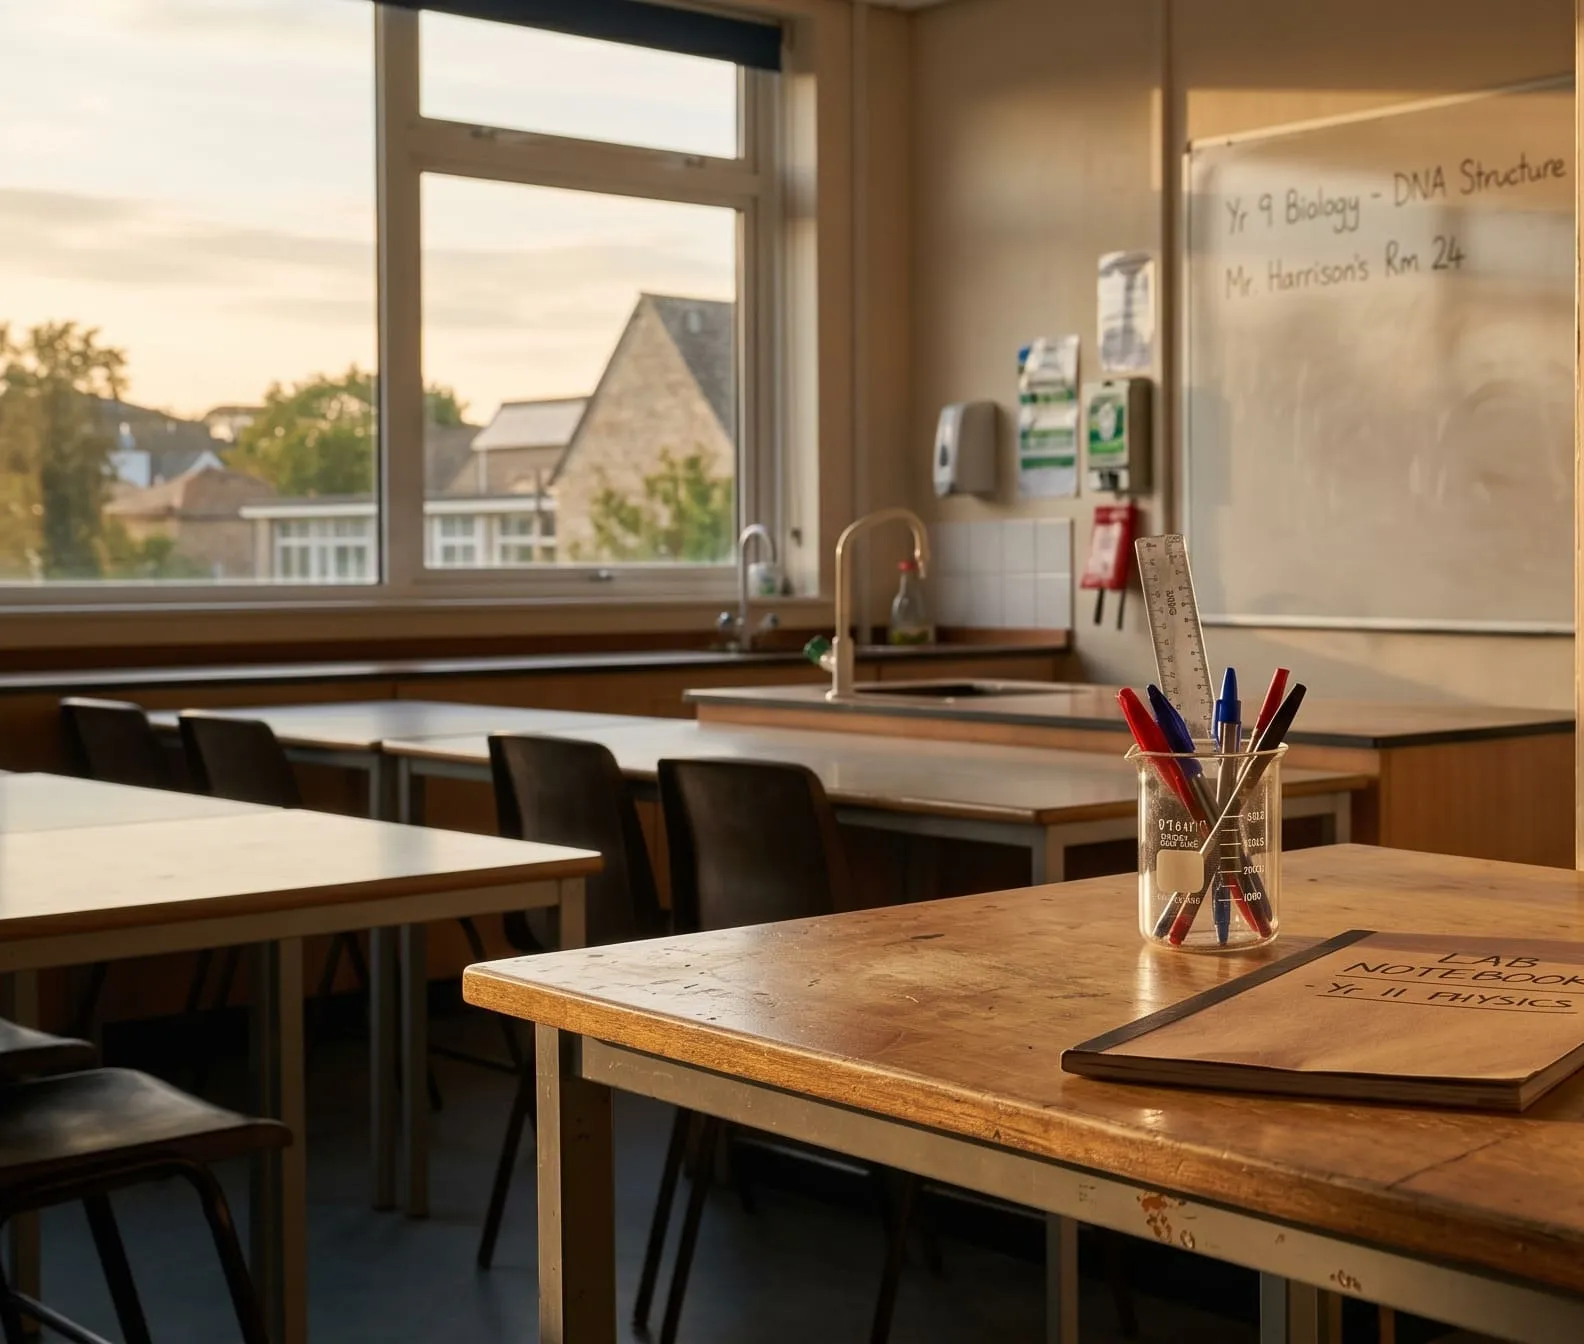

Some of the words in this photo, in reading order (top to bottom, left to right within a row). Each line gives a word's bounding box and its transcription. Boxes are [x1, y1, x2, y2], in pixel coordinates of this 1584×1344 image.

[1226, 201, 1248, 233] Yr
[1259, 194, 1274, 227] 9
[1286, 189, 1360, 233] Biology
[1394, 167, 1446, 209] DNA
[1460, 155, 1567, 194] Structure
[1226, 269, 1259, 298] Mr.
[1268, 255, 1369, 292] Harrison's
[1386, 240, 1418, 276] Rm
[1432, 236, 1465, 271] 24
[1438, 953, 1540, 968] LAB
[1328, 983, 1362, 994] Yr
[1428, 992, 1574, 1008] PHYSICS
